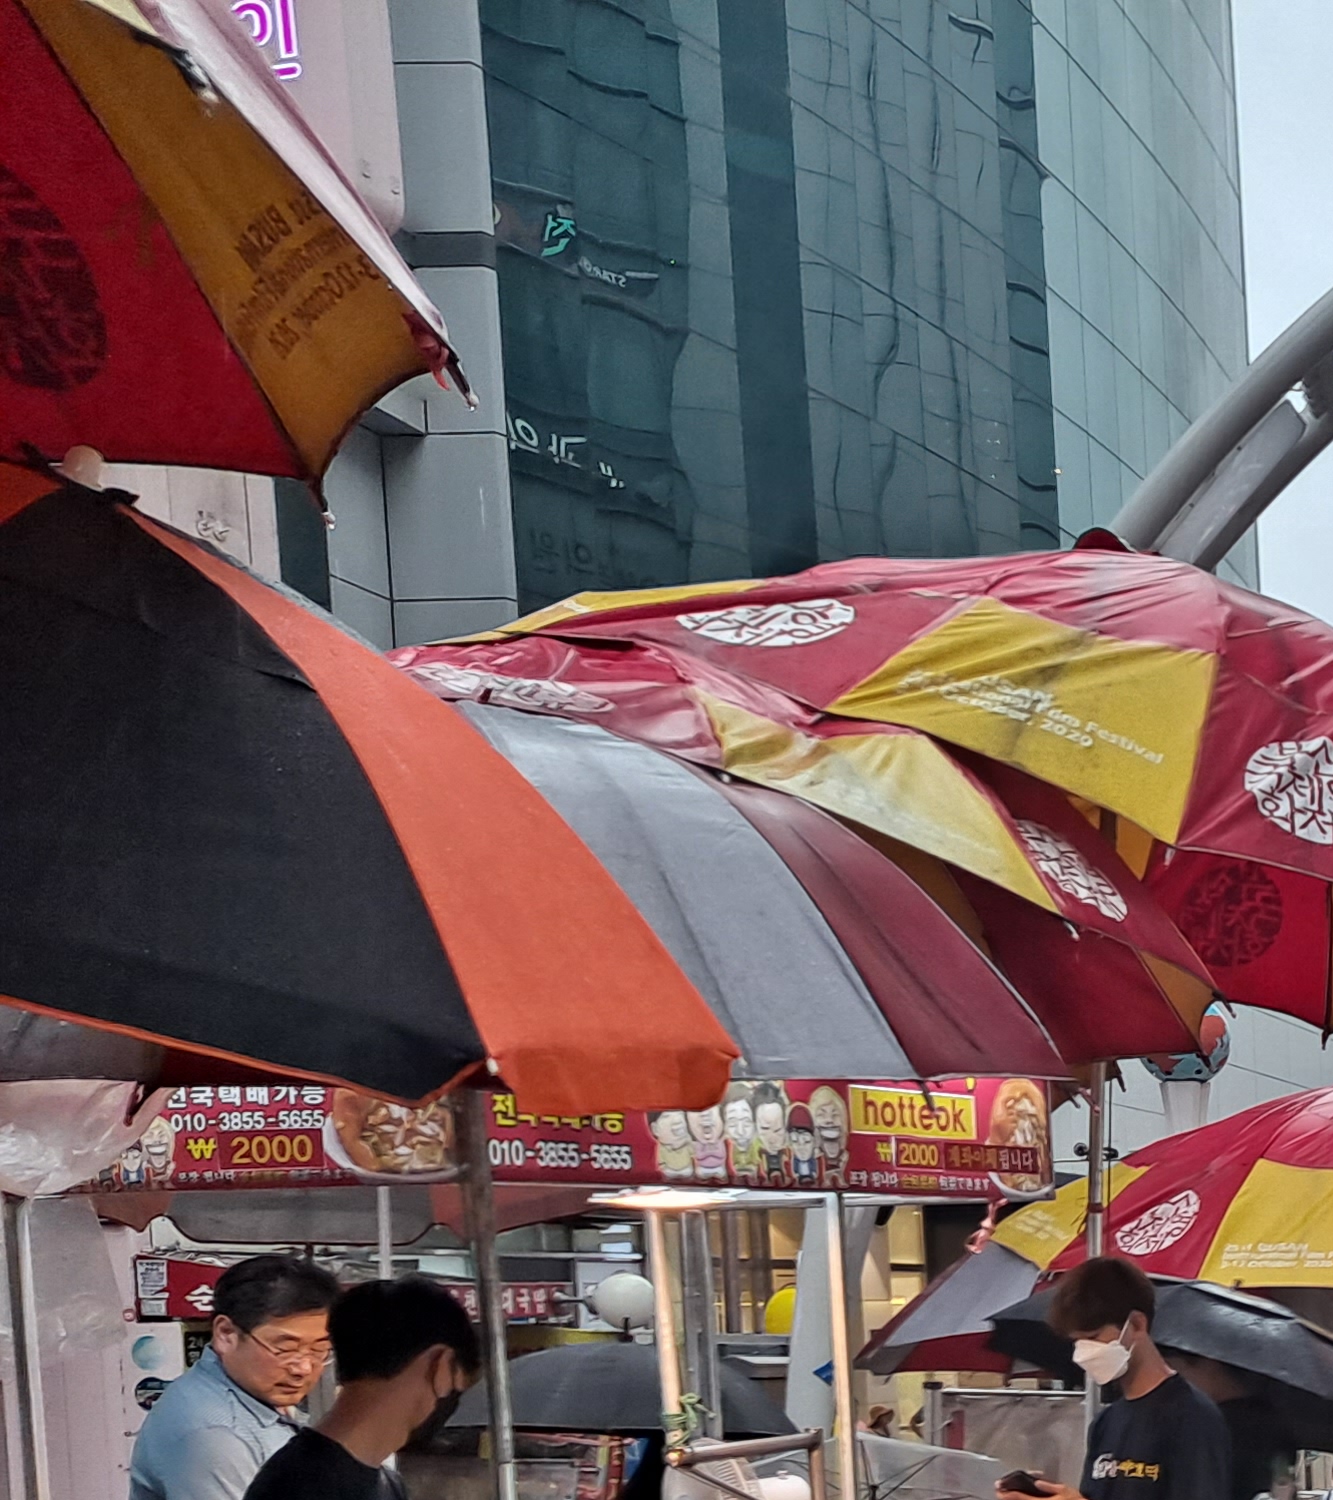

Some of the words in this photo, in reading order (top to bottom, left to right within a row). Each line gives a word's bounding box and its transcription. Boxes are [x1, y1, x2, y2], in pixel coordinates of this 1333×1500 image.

[1040, 717, 1095, 748] 2020
[170, 1109, 326, 1132] 010-3855-5655
[862, 1091, 967, 1132] hotteok
[230, 1134, 314, 1164] 2000
[487, 1138, 633, 1171] 010-3855-5655
[900, 1142, 939, 1166] 2000
